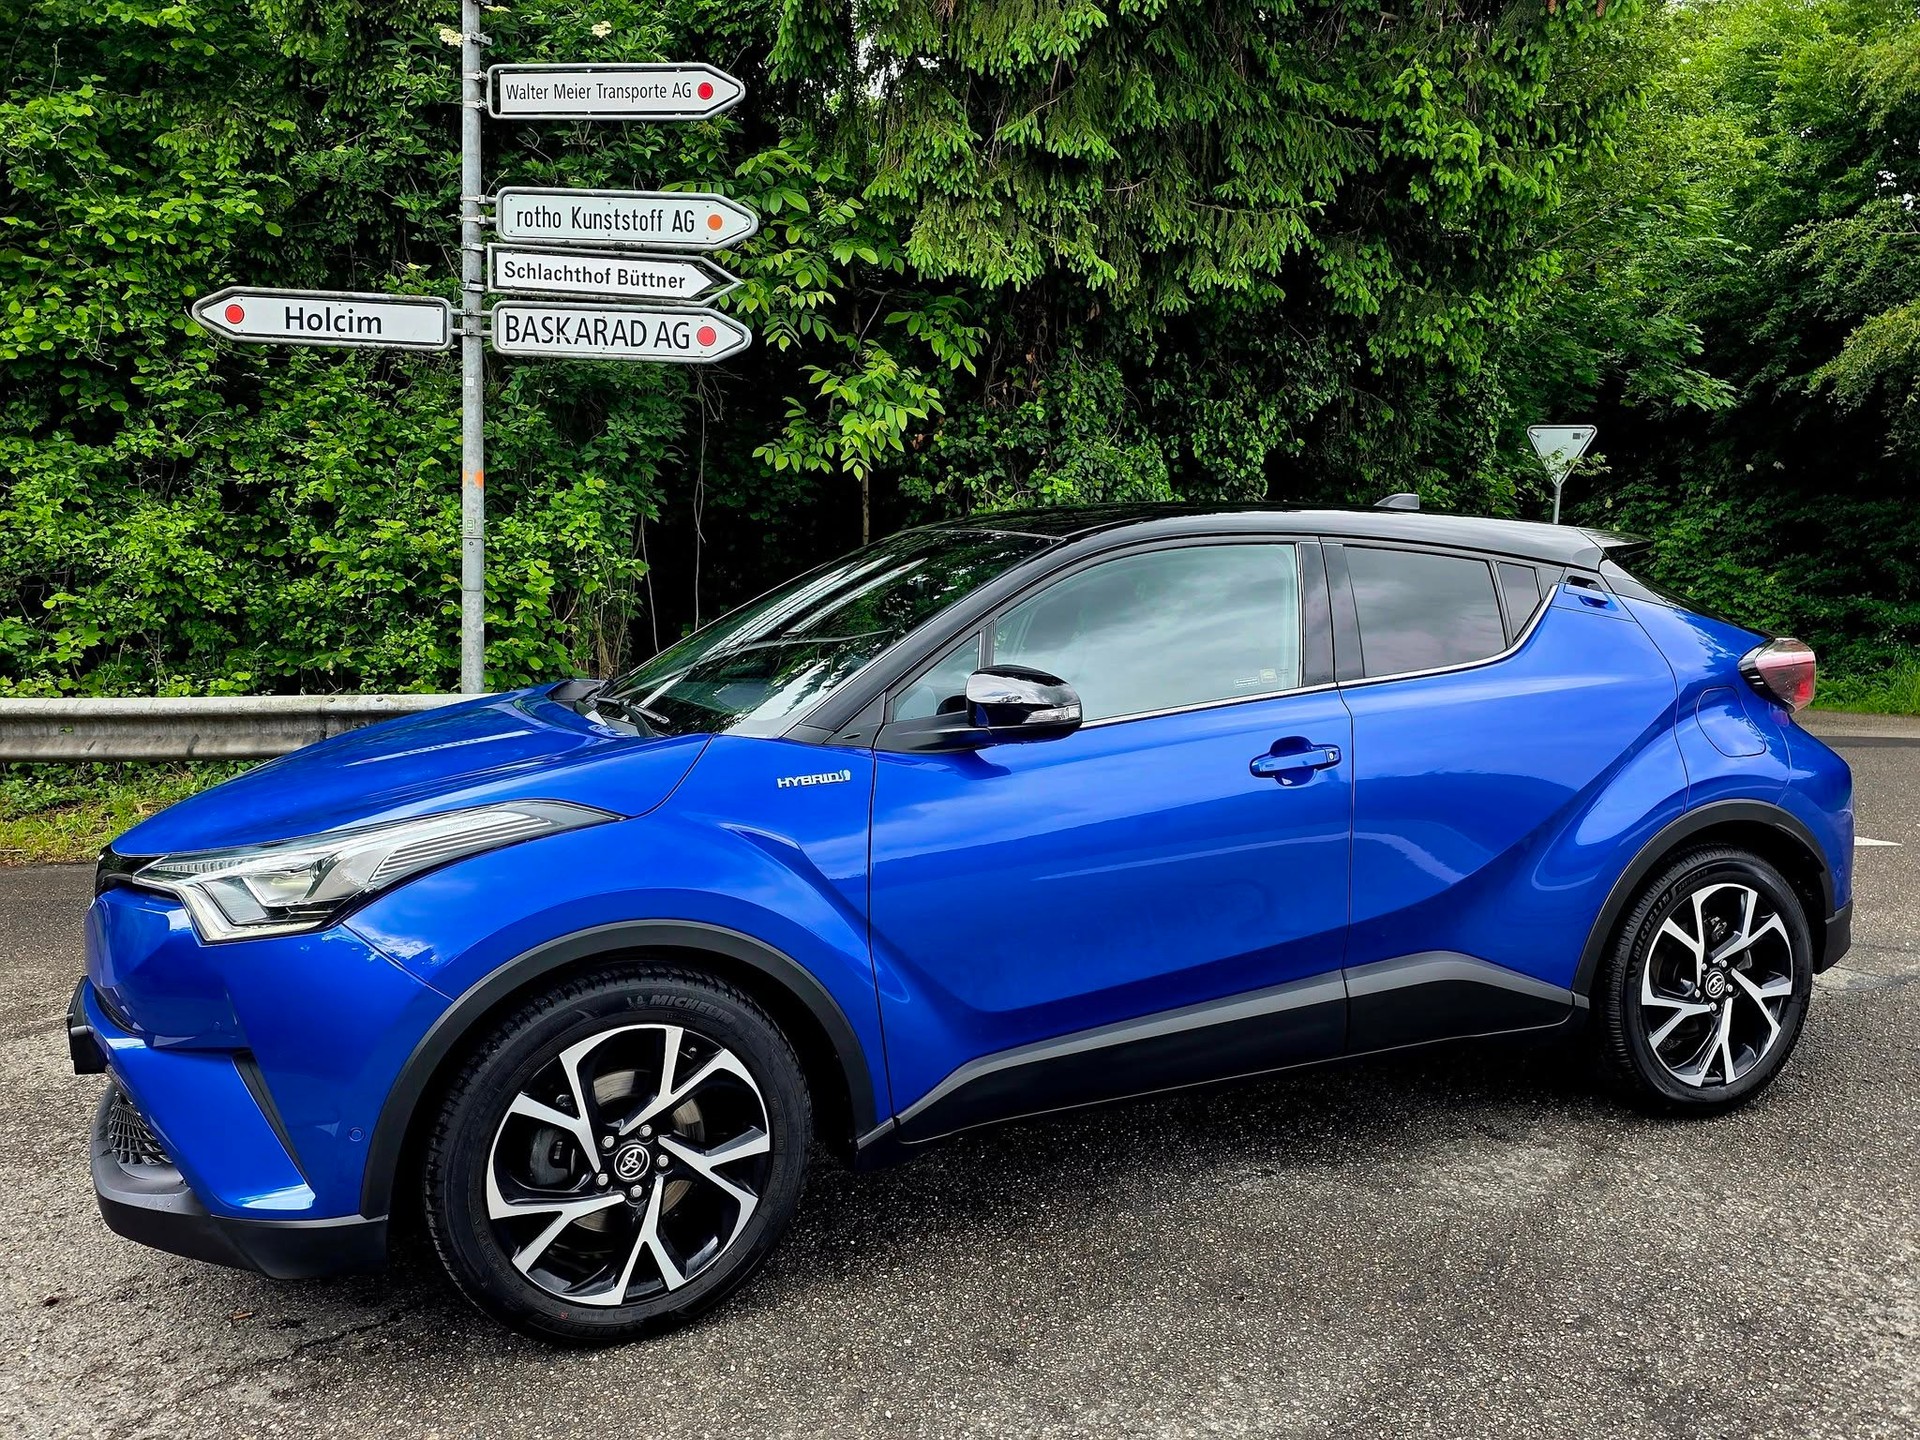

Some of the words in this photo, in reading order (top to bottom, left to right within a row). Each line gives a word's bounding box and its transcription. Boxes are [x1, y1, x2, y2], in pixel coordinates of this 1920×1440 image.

[505, 83, 549, 100] Walter
[553, 83, 592, 100] Meier
[596, 83, 667, 103] Transporte
[672, 82, 692, 99] AG
[516, 206, 562, 229] rotho
[571, 206, 663, 232] Kunststoff
[671, 209, 695, 233] AG
[504, 260, 611, 286] Schlachthof
[617, 268, 686, 290] Büttner
[284, 307, 382, 334] Holcim
[505, 314, 647, 348] BASKARAD
[653, 321, 691, 350] AG
[777, 771, 844, 788] HYBRID
[1633, 893, 1670, 960] MICHELIN
[649, 995, 736, 1024] MICHELIN
